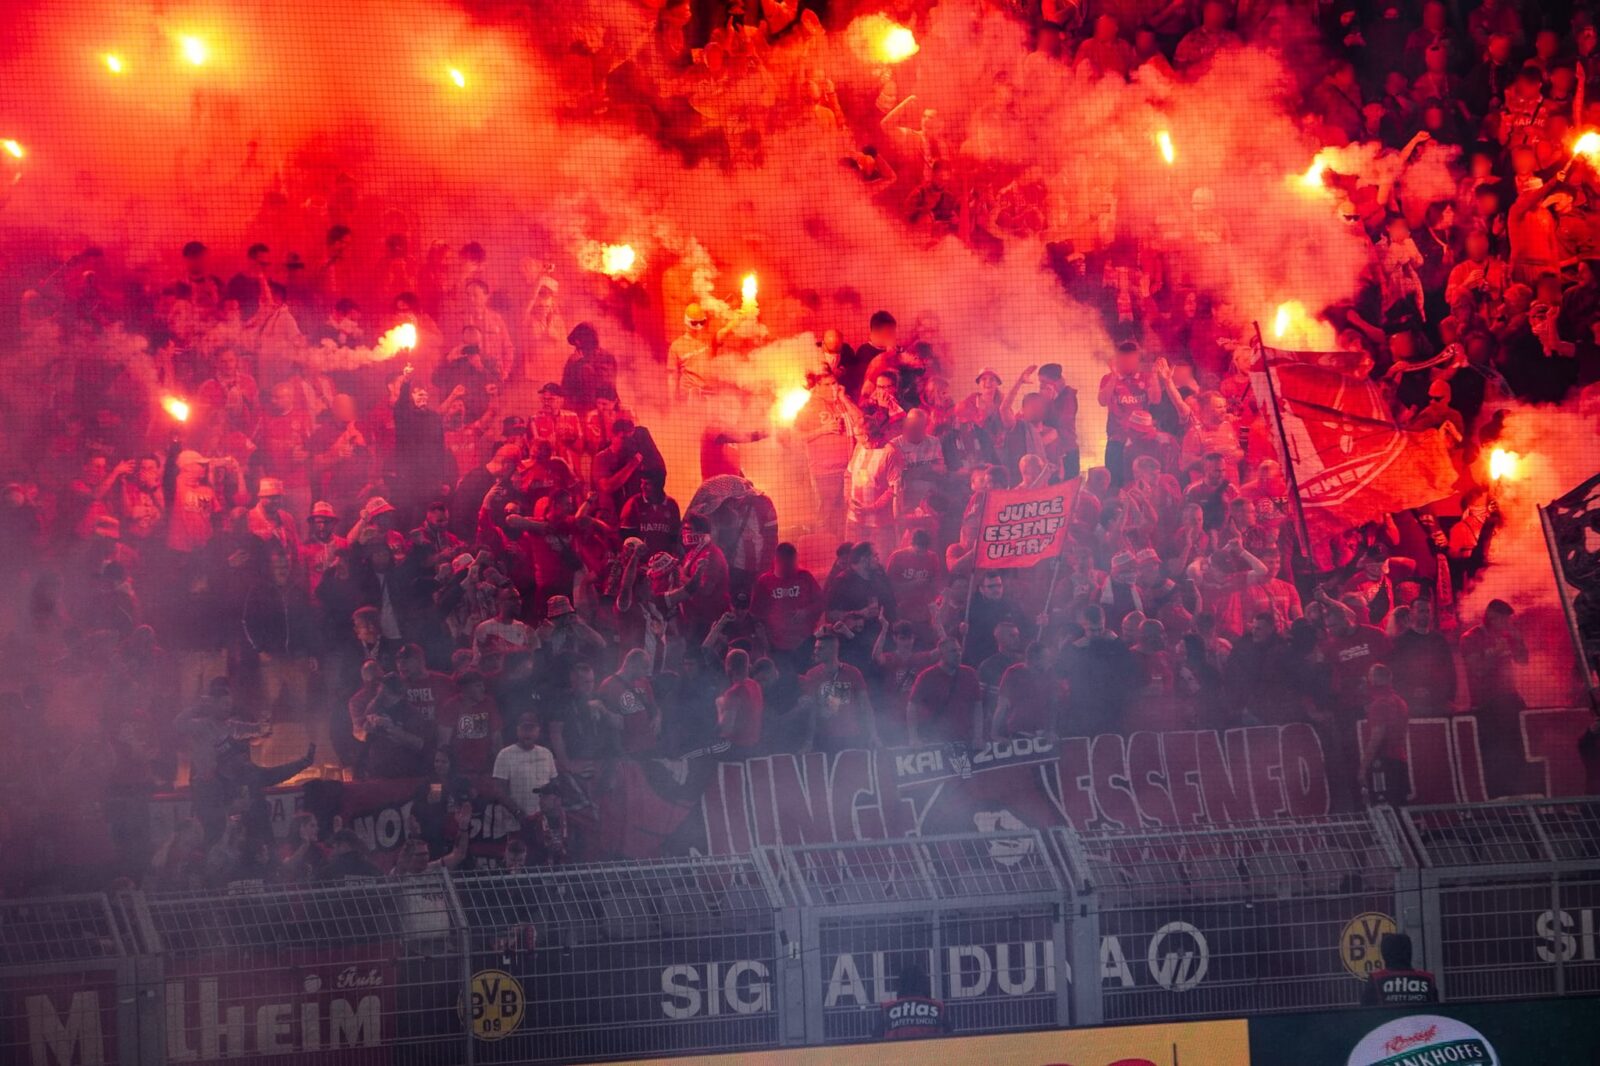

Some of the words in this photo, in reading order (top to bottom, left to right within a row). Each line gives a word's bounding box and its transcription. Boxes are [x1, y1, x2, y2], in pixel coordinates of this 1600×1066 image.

[998, 497, 1063, 523] JUNGE
[987, 535, 1055, 560] ULTRA
[896, 749, 944, 776] KAI
[660, 950, 898, 1020] SIGAL
[1383, 976, 1429, 994] atlas
[471, 978, 518, 1019] BVB
[888, 1001, 939, 1019] atlas
[482, 1018, 502, 1033] 09
